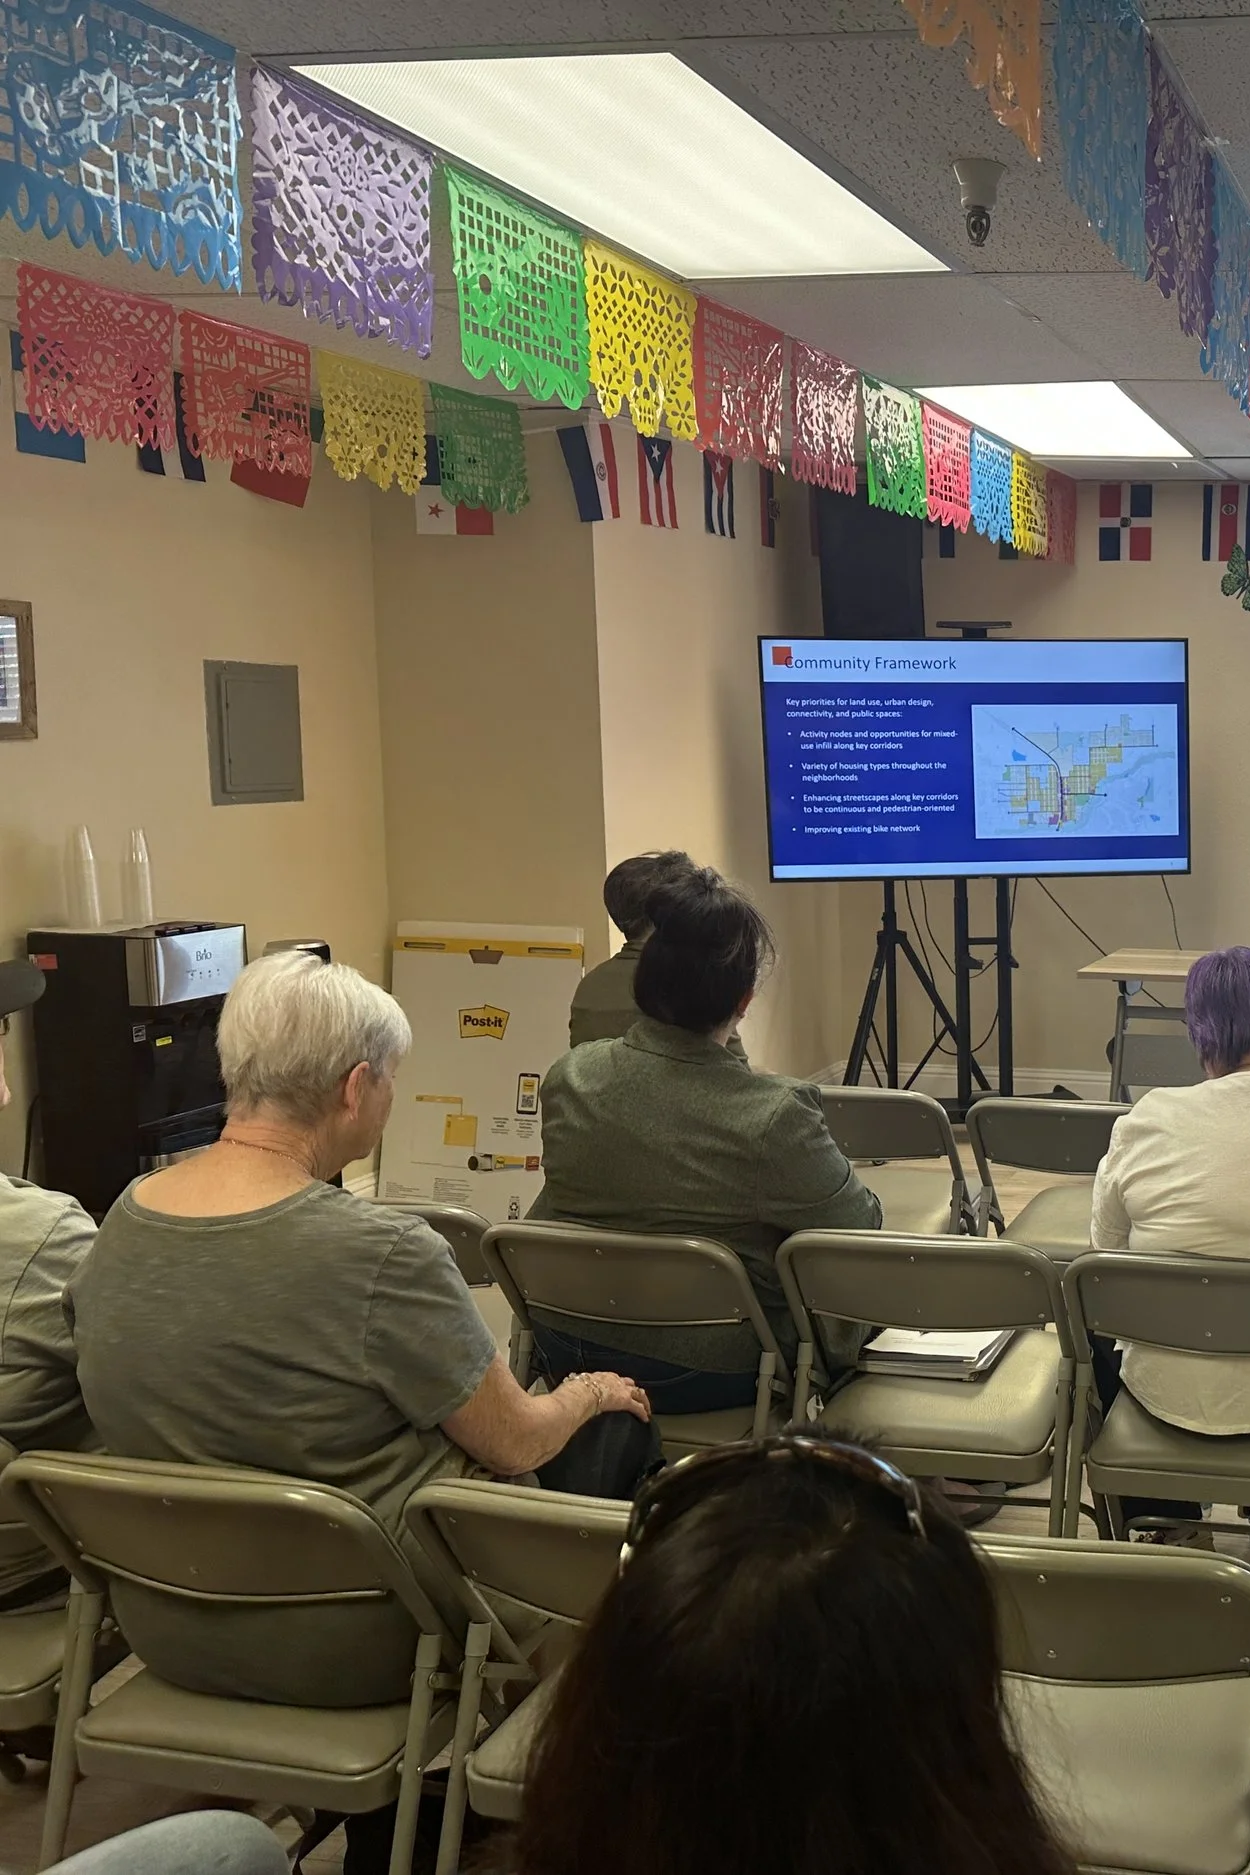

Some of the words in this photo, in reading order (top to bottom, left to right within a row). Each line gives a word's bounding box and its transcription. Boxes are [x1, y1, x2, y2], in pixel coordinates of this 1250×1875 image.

[785, 655, 870, 672] Community
[875, 656, 956, 669] Framework
[786, 699, 800, 707] Key
[801, 699, 835, 707] priorities
[837, 698, 848, 706] for
[850, 698, 865, 706] land
[884, 698, 906, 706] urban
[852, 710, 874, 718] public
[800, 731, 828, 739] Activity
[870, 730, 919, 738] opportunities
[834, 742, 854, 750] along
[856, 742, 868, 750] key
[802, 763, 828, 771] Variety
[830, 762, 837, 770] of
[839, 762, 868, 771] housing
[870, 763, 889, 771] types
[891, 762, 932, 771] throughout
[802, 774, 858, 782] neighborhoods
[803, 794, 841, 803] Enhancing
[891, 794, 910, 802] along
[912, 794, 924, 802] key
[883, 805, 954, 813] pedestrian-oriented
[805, 825, 842, 834] Improving
[843, 825, 871, 834] existing
[196, 949, 212, 961] Brio
